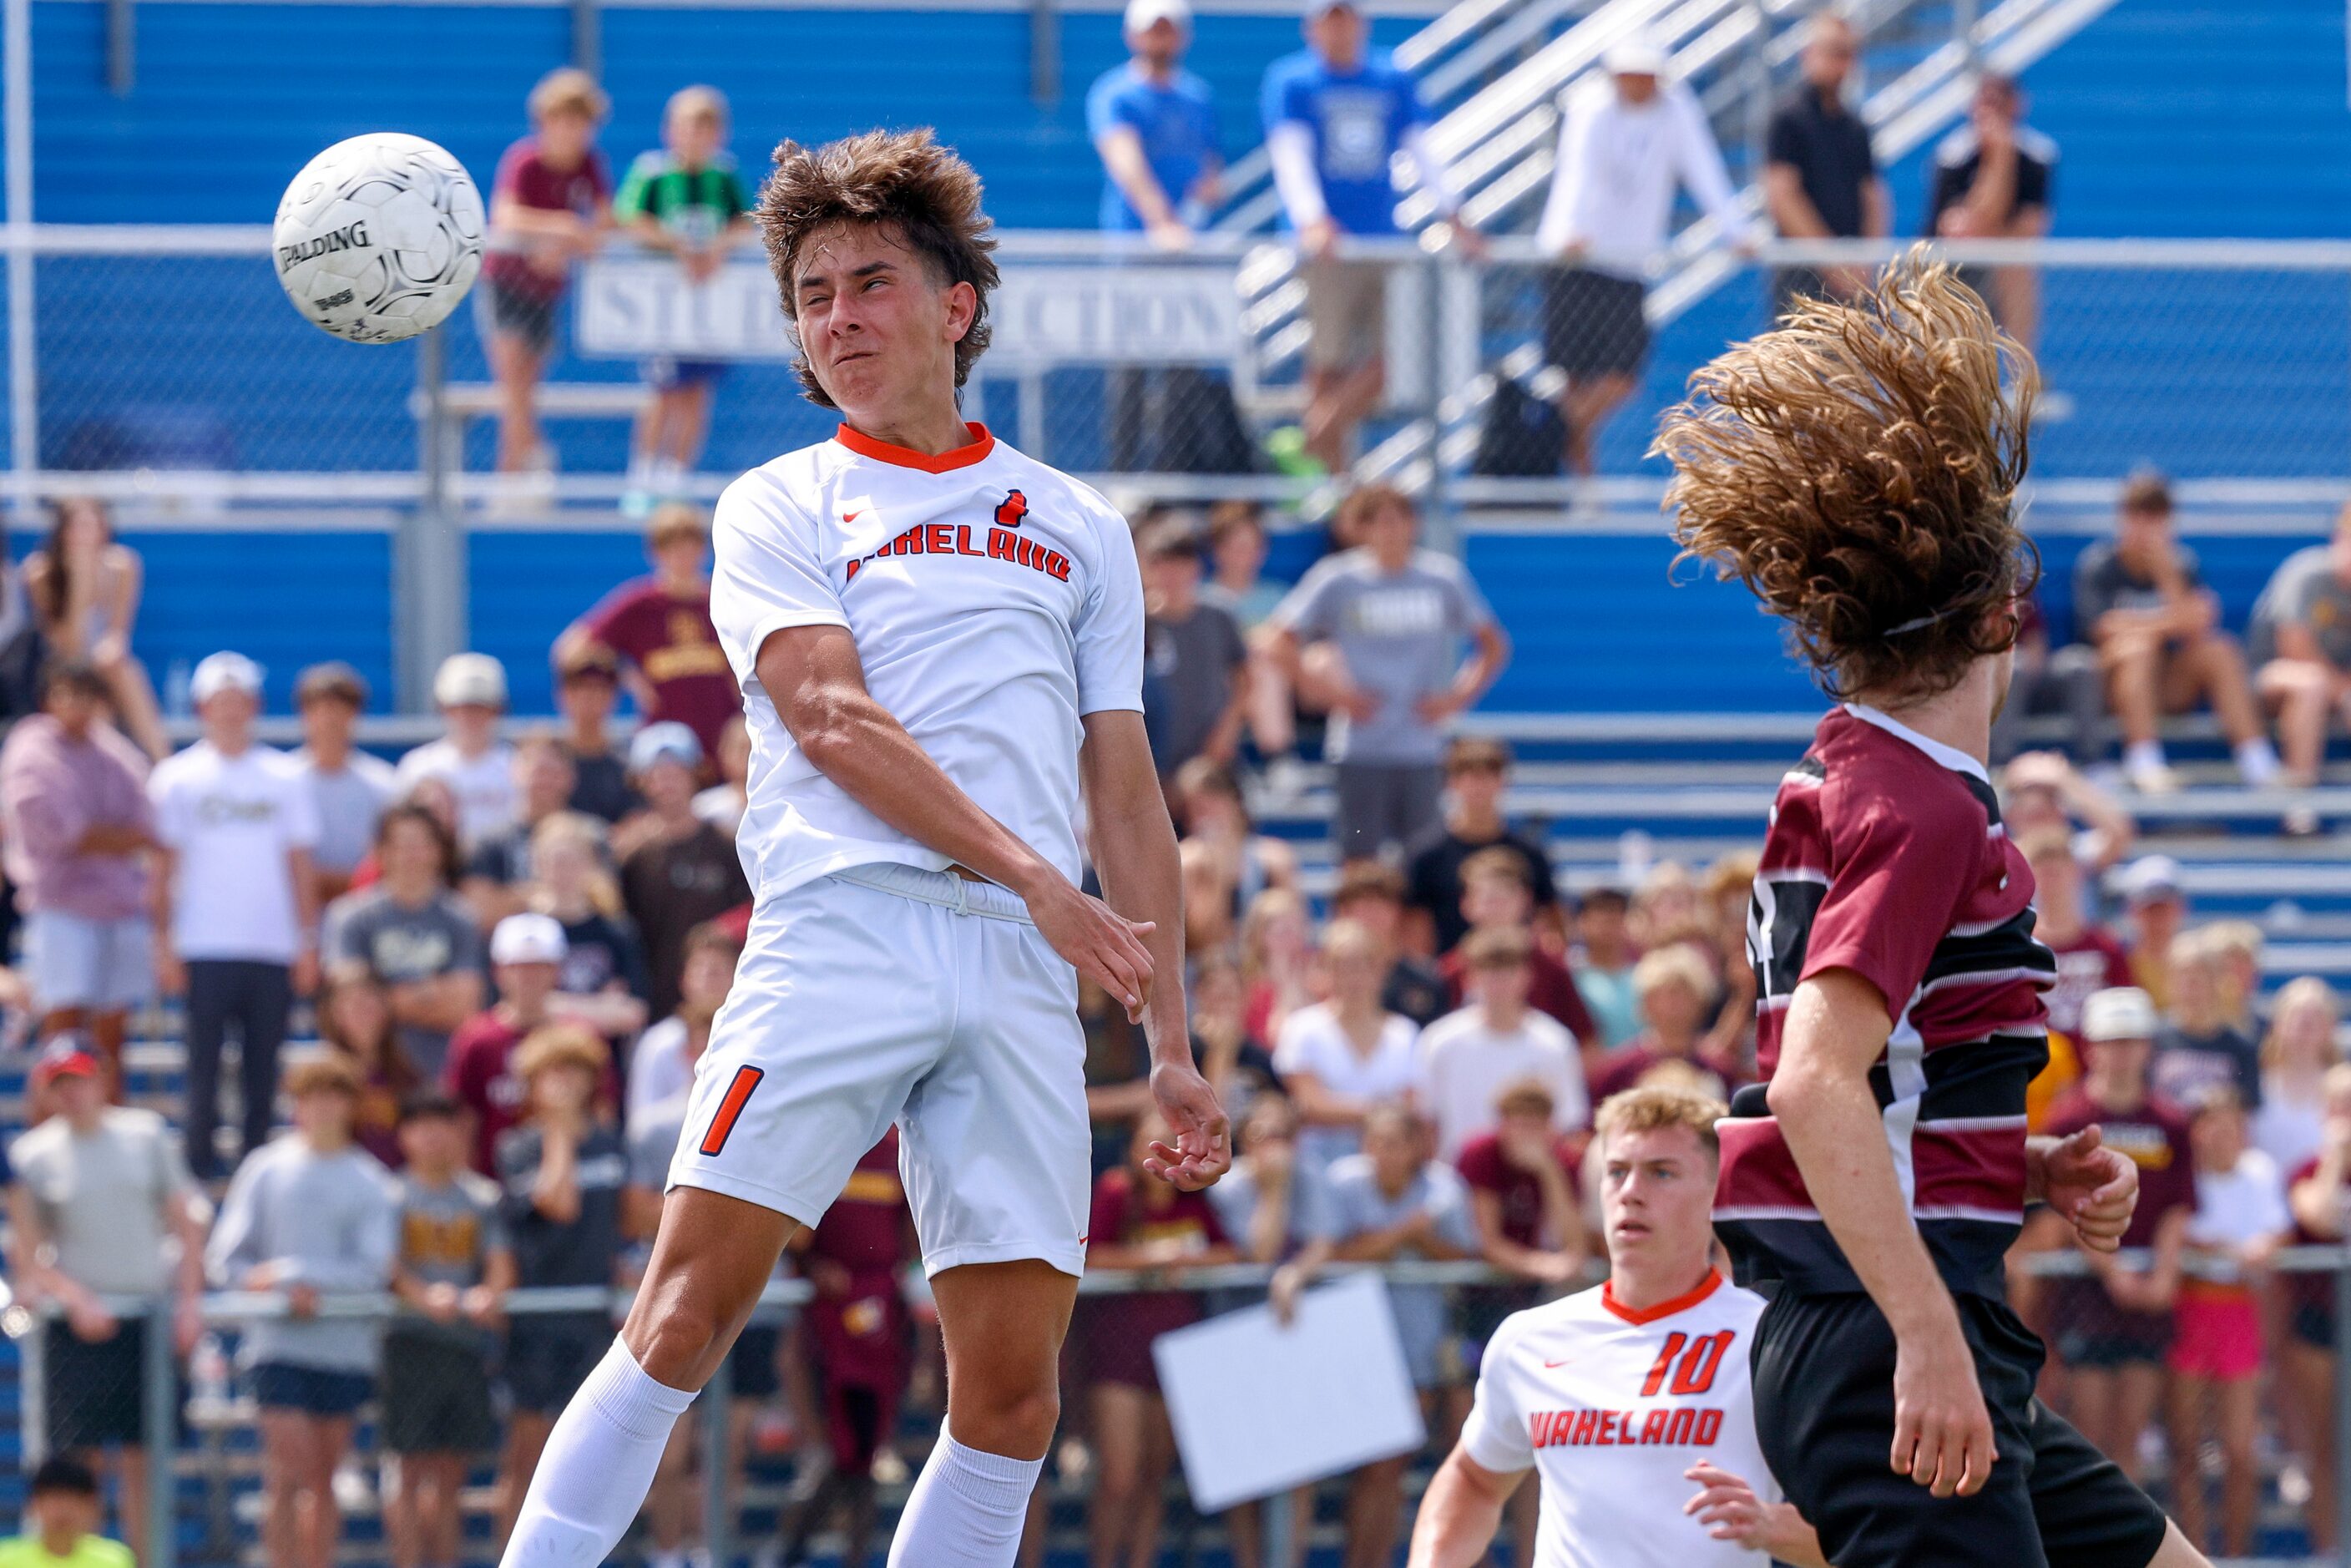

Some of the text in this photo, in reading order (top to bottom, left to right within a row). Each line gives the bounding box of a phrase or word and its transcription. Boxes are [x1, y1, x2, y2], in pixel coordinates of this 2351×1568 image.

[846, 524, 1071, 584] KELAND
[699, 1064, 765, 1157] 1
[1640, 1329, 1736, 1397] 10
[1529, 1408, 1724, 1449] WAKELAND
